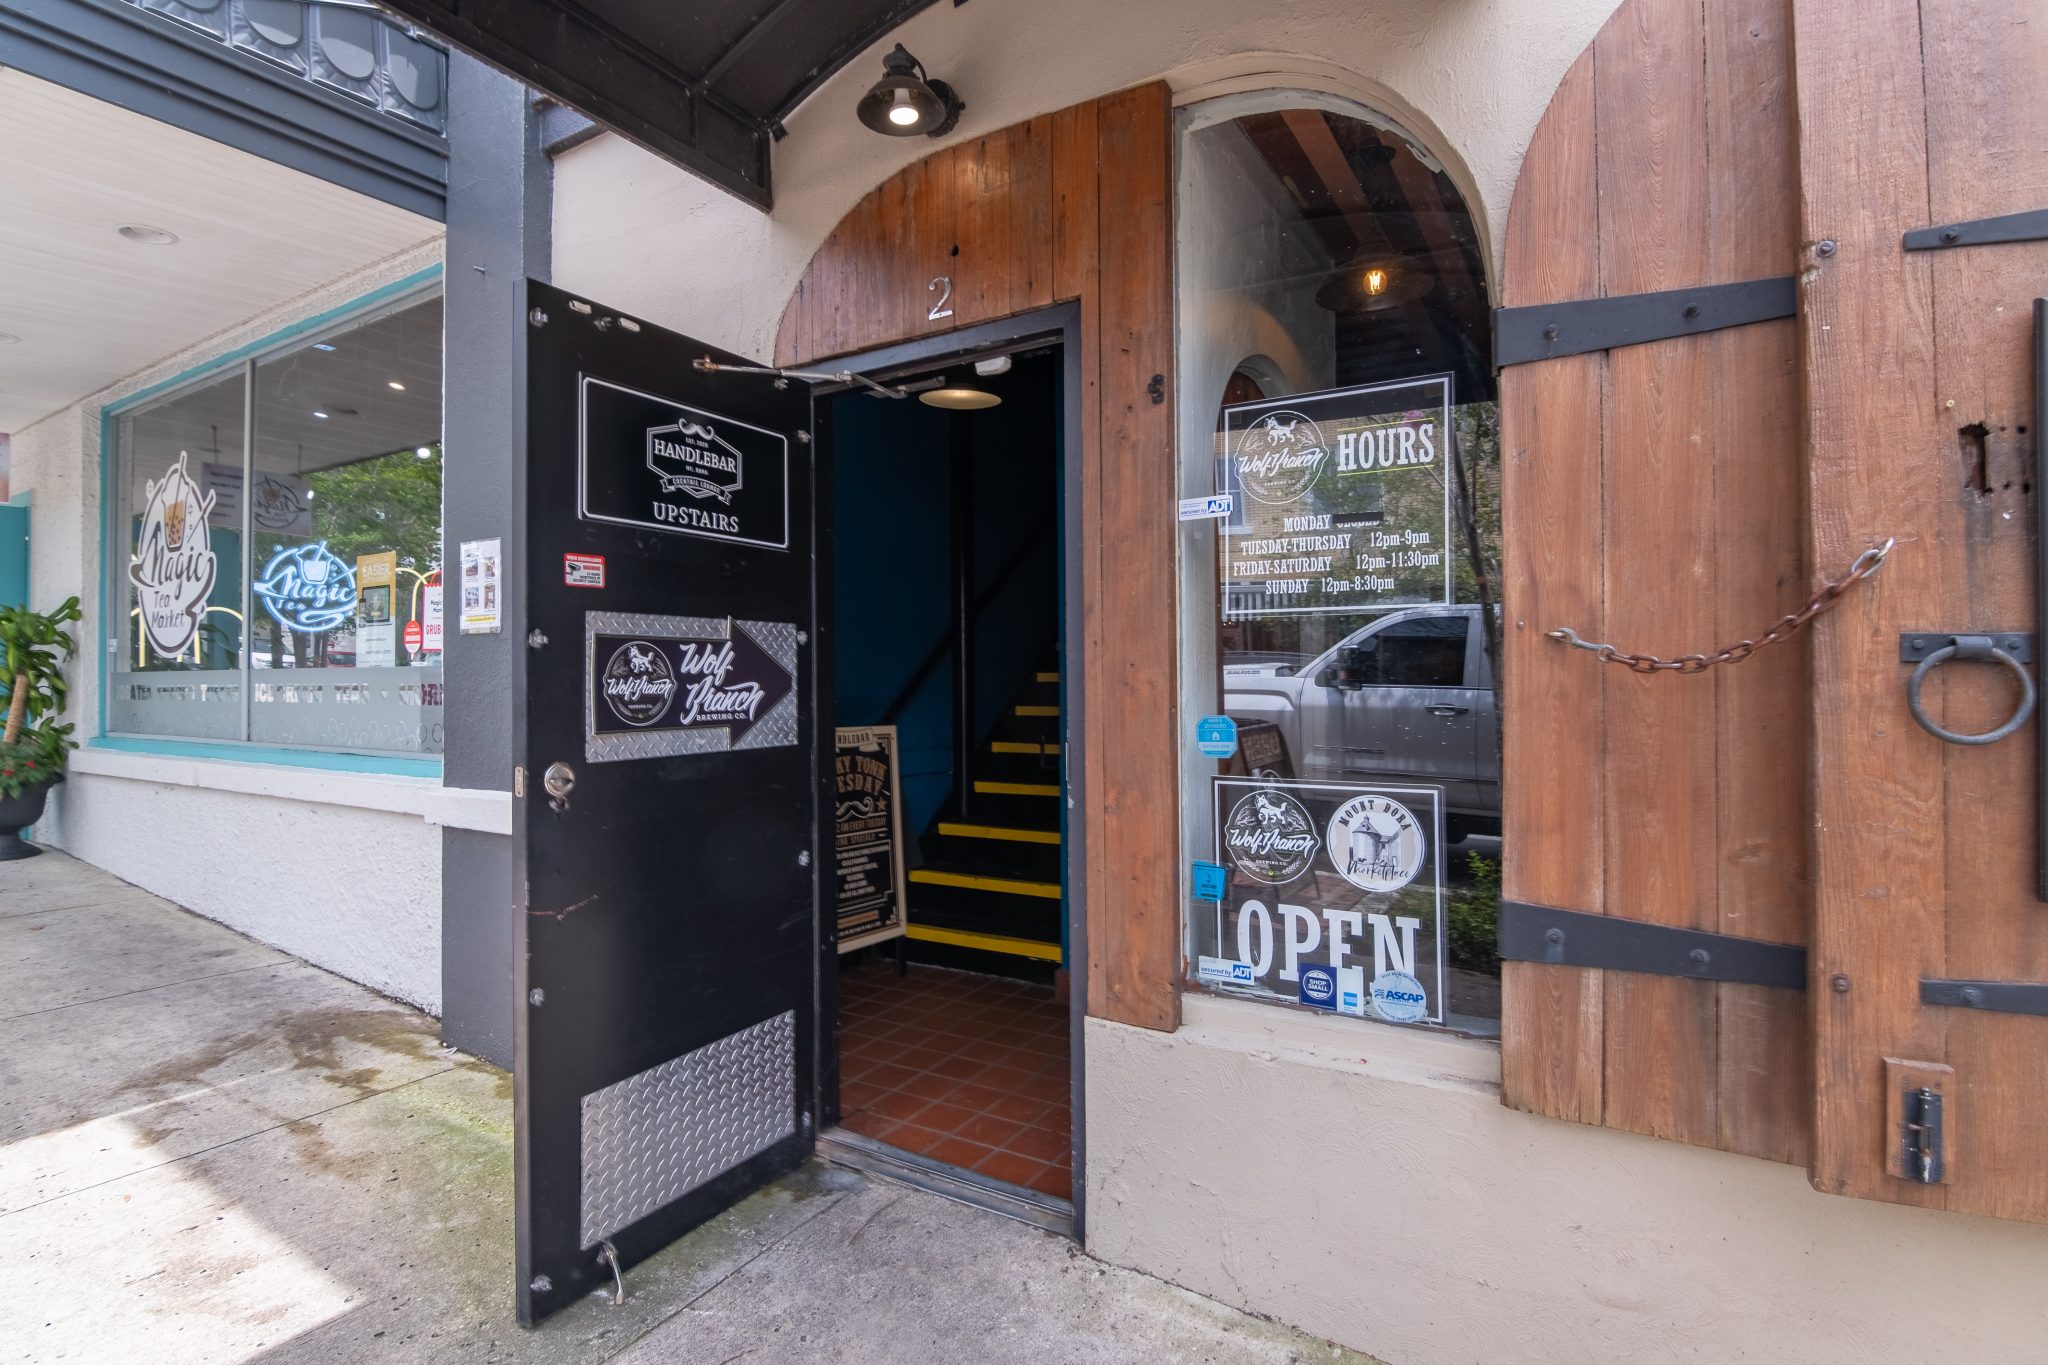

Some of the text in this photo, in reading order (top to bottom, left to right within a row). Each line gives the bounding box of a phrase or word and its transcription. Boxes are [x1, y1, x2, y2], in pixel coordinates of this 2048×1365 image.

[928, 276, 953, 320] 2
[653, 438, 737, 473] HANDLEBAR
[1337, 423, 1435, 473] HOURS
[1238, 447, 1324, 478] Wolf Branch
[672, 478, 721, 494] COCKTAIL LOUNGE
[652, 501, 739, 533] UPSTAIRS
[1208, 500, 1230, 513] ADT
[1283, 514, 1331, 532] MONDAY
[1240, 531, 1430, 556] TUESDAY-THURSDAY 12pm-9pm
[145, 521, 206, 600] Magic
[362, 562, 390, 578] EASIER
[1233, 553, 1439, 576] FRIDAY-SATURDAY 12pm-11:30pm
[266, 568, 354, 607] Magic
[1265, 575, 1395, 595] SUNDAY 12pm-8:30pm
[154, 591, 170, 608] Tea
[151, 609, 184, 628] Market
[679, 640, 735, 681] Wolf
[254, 684, 274, 702] ICE
[607, 674, 673, 701] Wolf Branch
[680, 681, 766, 725] Branch
[696, 713, 733, 721] BREWING
[1338, 799, 1412, 831] MOUNT DORA
[850, 833, 876, 844] SPECIALS
[1229, 828, 1315, 858] Wolf Branch
[1347, 855, 1410, 881] Marketplace
[1237, 899, 1421, 987] OPEN
[1233, 967, 1251, 978] ADT
[1386, 990, 1424, 1002] ASCAP
